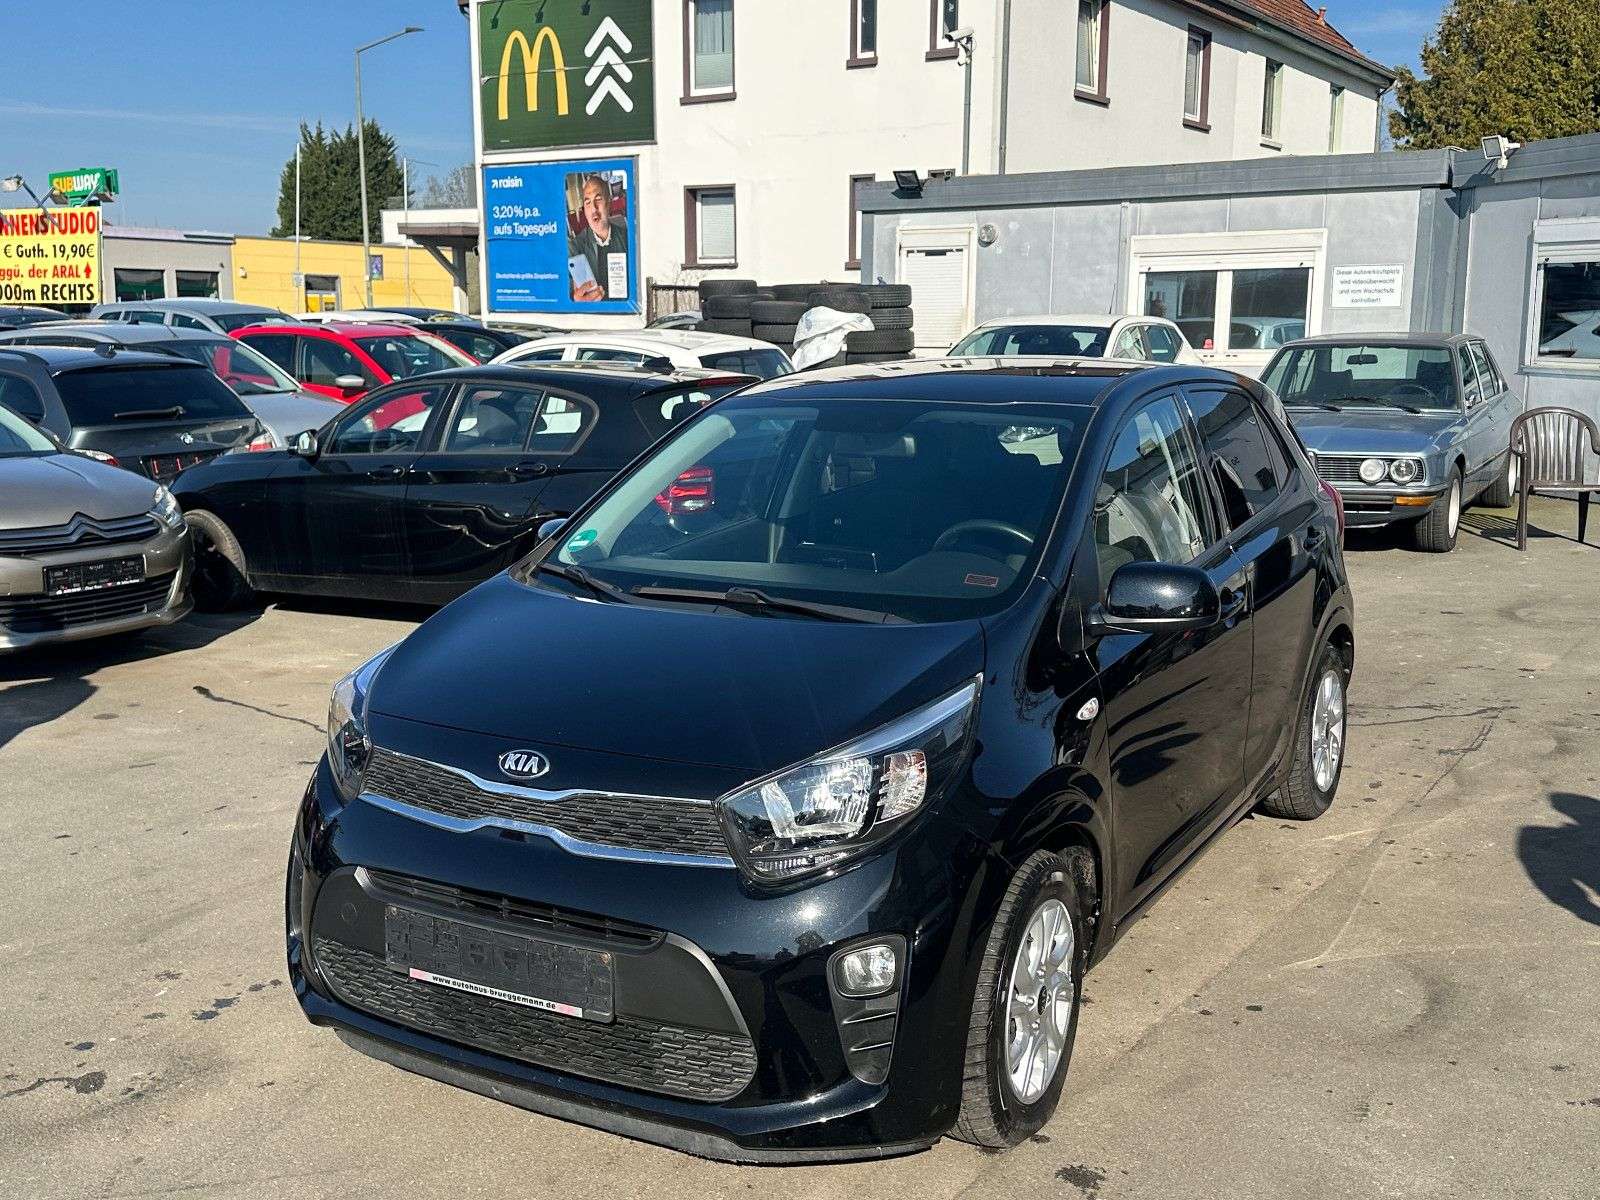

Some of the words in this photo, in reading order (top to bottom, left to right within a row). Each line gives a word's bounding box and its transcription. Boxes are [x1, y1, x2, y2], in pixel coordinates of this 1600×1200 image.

[53, 172, 101, 193] SUBWAY
[498, 176, 523, 188] raisin
[493, 222, 512, 235] aufs
[513, 221, 558, 236] Tagesgeld
[16, 243, 48, 258] Guth.
[52, 243, 95, 261] 19,90€
[28, 264, 48, 278] der
[52, 265, 81, 278] ARAL
[40, 283, 95, 301] RECHTS
[504, 753, 539, 773] KIA
